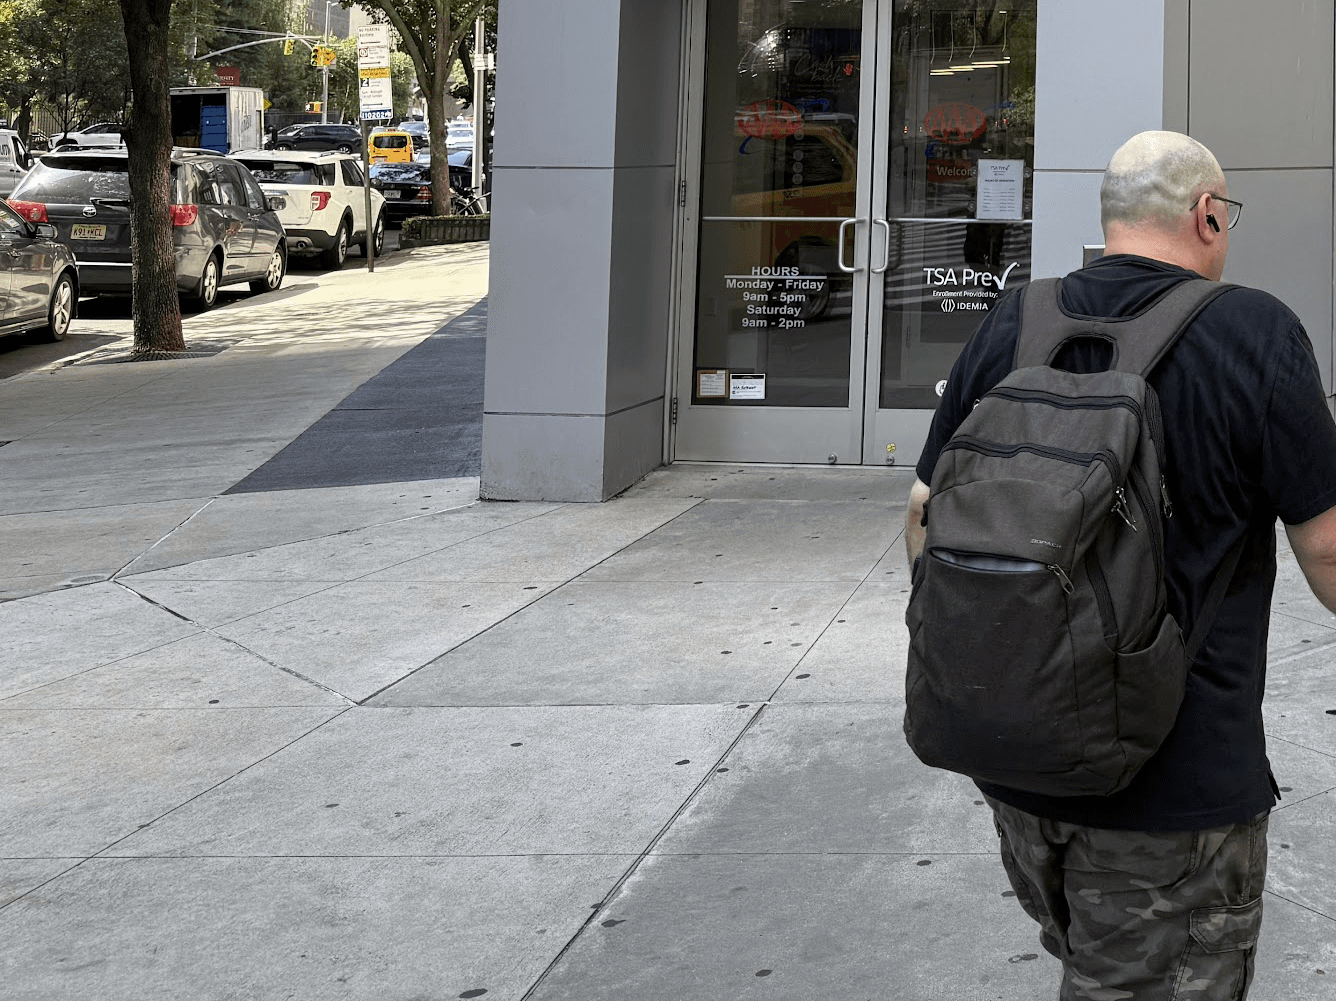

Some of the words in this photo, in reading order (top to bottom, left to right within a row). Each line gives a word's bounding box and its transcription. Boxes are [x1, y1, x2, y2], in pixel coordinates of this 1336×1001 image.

[751, 266, 800, 276] HOURS
[923, 267, 958, 285] TSA
[962, 268, 992, 286] Pre
[726, 279, 774, 291] Monday
[785, 279, 824, 291] Friday
[743, 291, 768, 301] 9am
[780, 292, 806, 304] 5pm
[746, 304, 802, 317] Saturday
[957, 302, 988, 310] IDEMIA
[741, 318, 767, 327] 9am
[778, 318, 805, 329] 2pm
